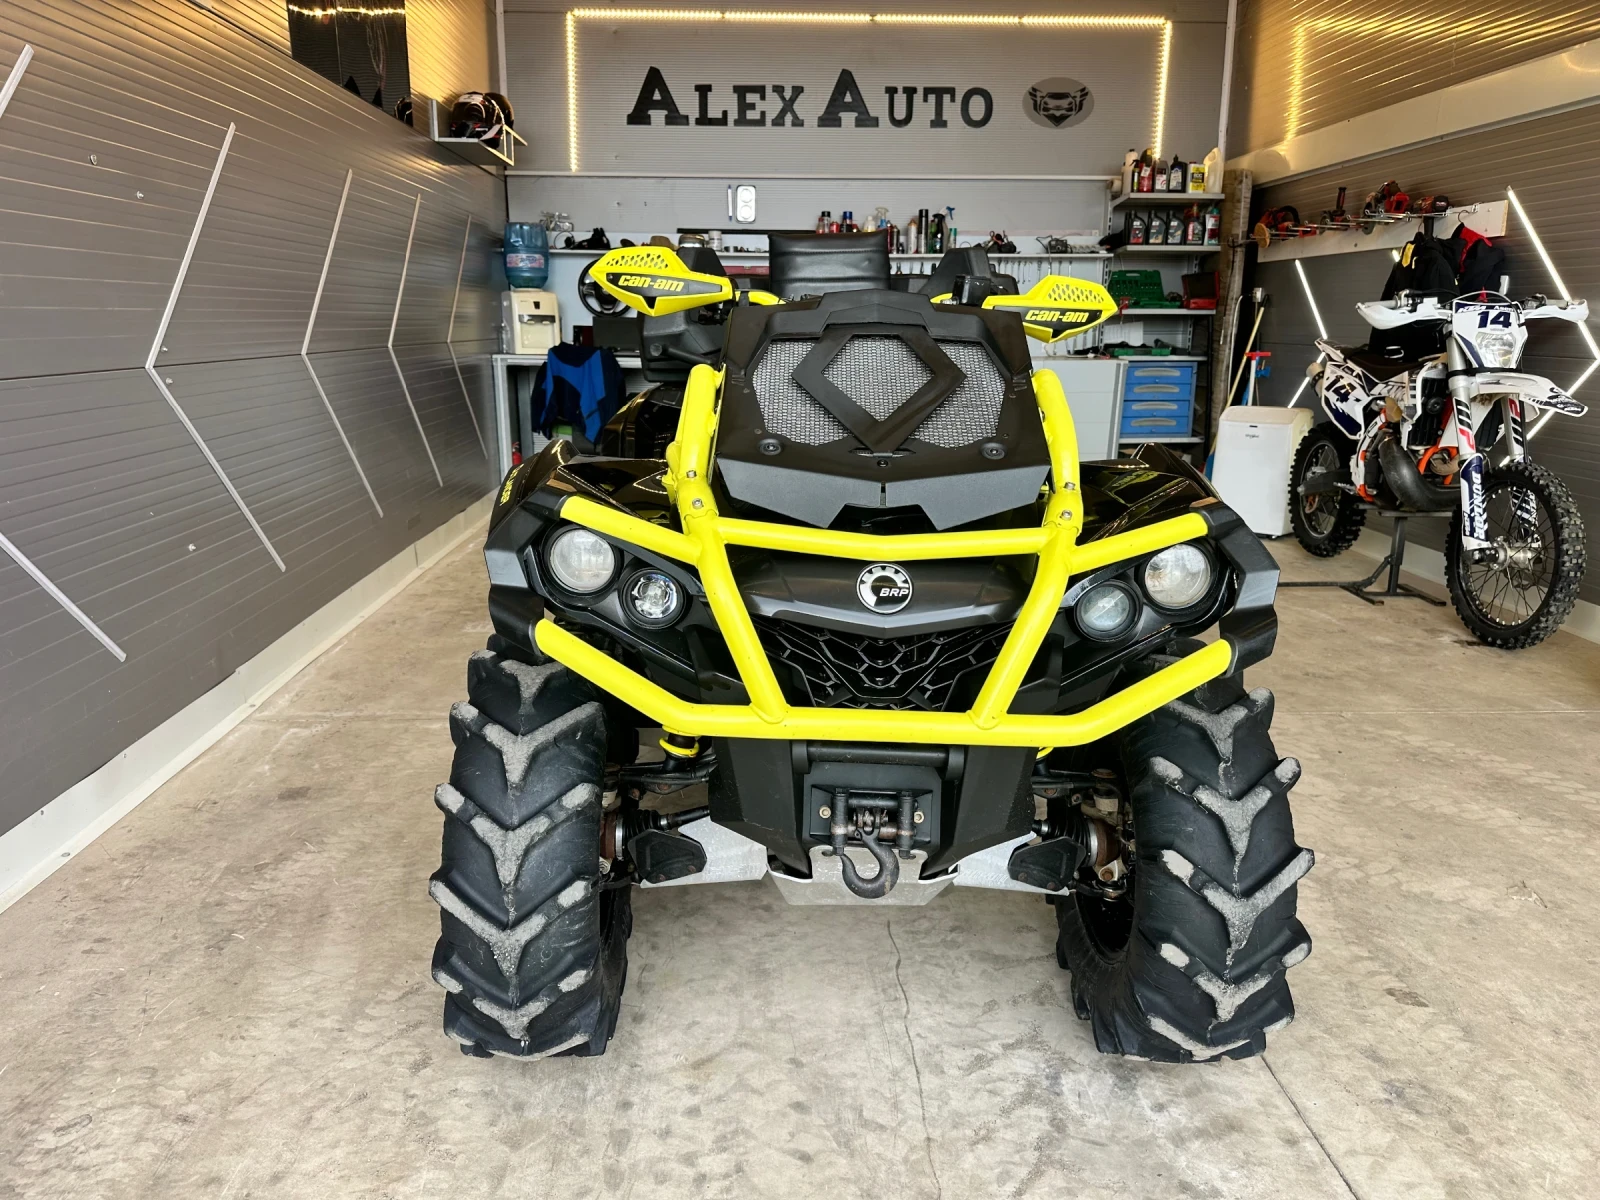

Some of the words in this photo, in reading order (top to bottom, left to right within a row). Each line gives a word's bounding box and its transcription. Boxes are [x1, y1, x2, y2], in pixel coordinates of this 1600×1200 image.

[618, 274, 685, 293] can-am
[1024, 308, 1090, 323] can-am
[1477, 310, 1512, 330] 14
[1324, 374, 1357, 404] 14
[1471, 470, 1487, 540] DUNLOP
[879, 587, 909, 598] BRP
